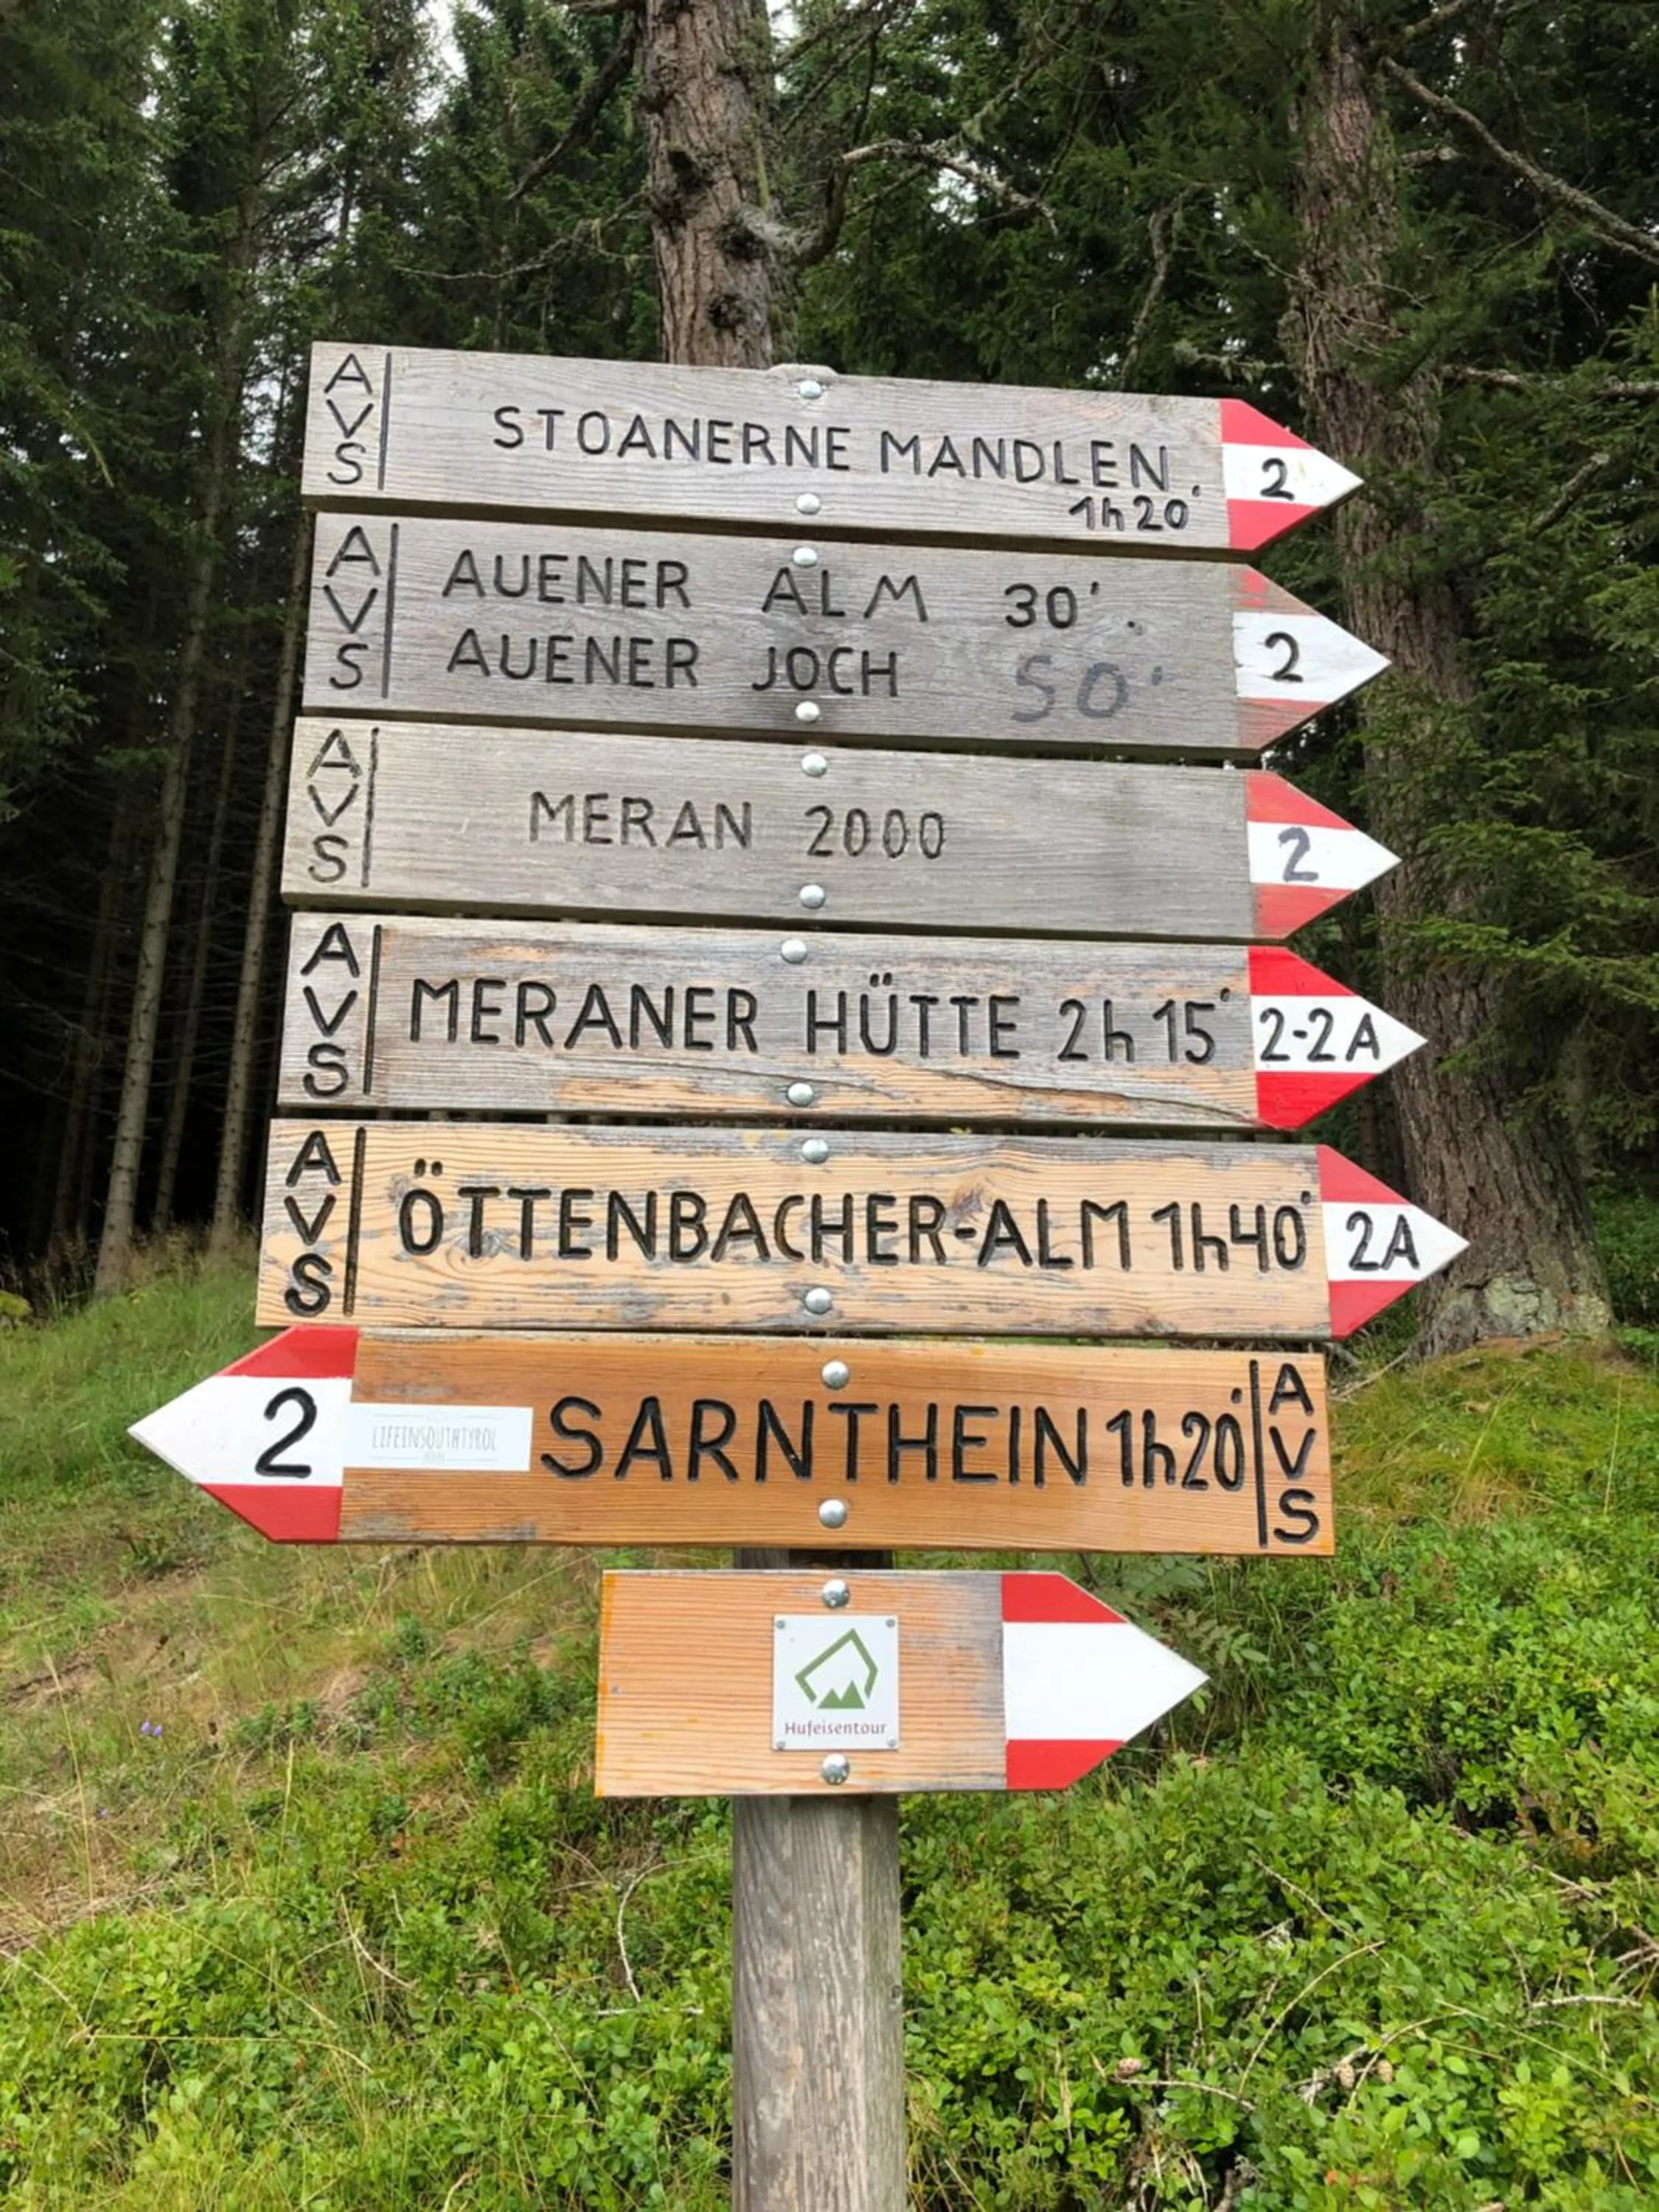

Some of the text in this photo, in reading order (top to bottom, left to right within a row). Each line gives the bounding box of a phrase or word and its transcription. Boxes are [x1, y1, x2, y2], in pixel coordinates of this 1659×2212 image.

[324, 352, 374, 485] AVS
[493, 406, 1170, 492] STOANERNE MANDLEN
[1260, 457, 1295, 501] 2
[323, 525, 381, 690] AVS
[442, 549, 1100, 630] AUENER ALM 30'
[446, 627, 700, 689] AUENER
[751, 646, 899, 697] JOCH
[1263, 631, 1304, 684] 2
[306, 728, 363, 883] AVS
[529, 790, 945, 860] MERAN 2000
[1278, 827, 1319, 883] 2
[300, 922, 361, 1099] AVS
[409, 978, 759, 1054] MERANER
[806, 973, 1021, 1058] HÜTTE
[1057, 998, 1136, 1065] 2h
[1259, 1007, 1381, 1064] 2-2A
[284, 1130, 342, 1318] AVS
[399, 1158, 1130, 1271] ÖTTENBACHER-ALM
[1346, 1211, 1420, 1270] 2A
[254, 1387, 318, 1479] 2
[540, 1395, 1088, 1489] SARNTHEIN
[1268, 1363, 1321, 1545] AVS
[784, 1719, 887, 1737] Hufeisentour
